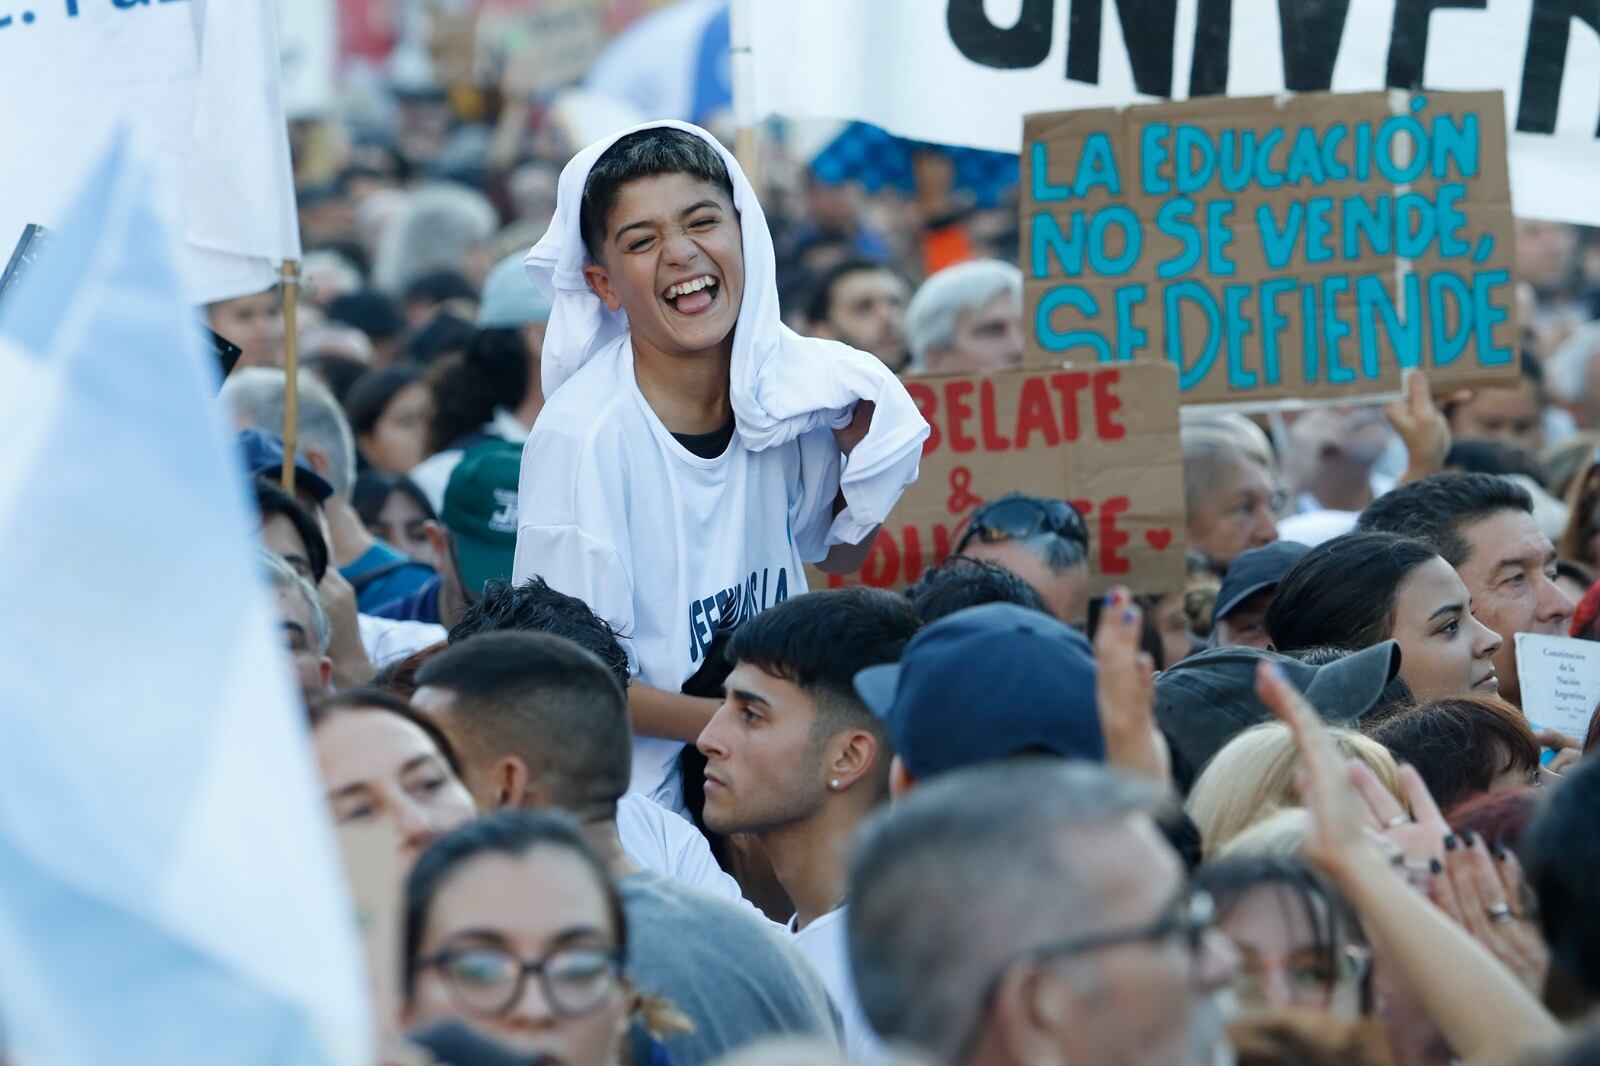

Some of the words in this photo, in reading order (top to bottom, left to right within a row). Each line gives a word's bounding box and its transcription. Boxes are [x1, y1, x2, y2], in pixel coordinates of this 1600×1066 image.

[1031, 130, 1121, 202] LA
[1141, 94, 1480, 197] EDUCACIÓN
[1031, 204, 1143, 279] NO
[1155, 196, 1236, 280] SE
[1255, 182, 1494, 270] VENDE,
[1162, 269, 1513, 391] DEFIENDE
[904, 368, 1126, 456] BELATE
